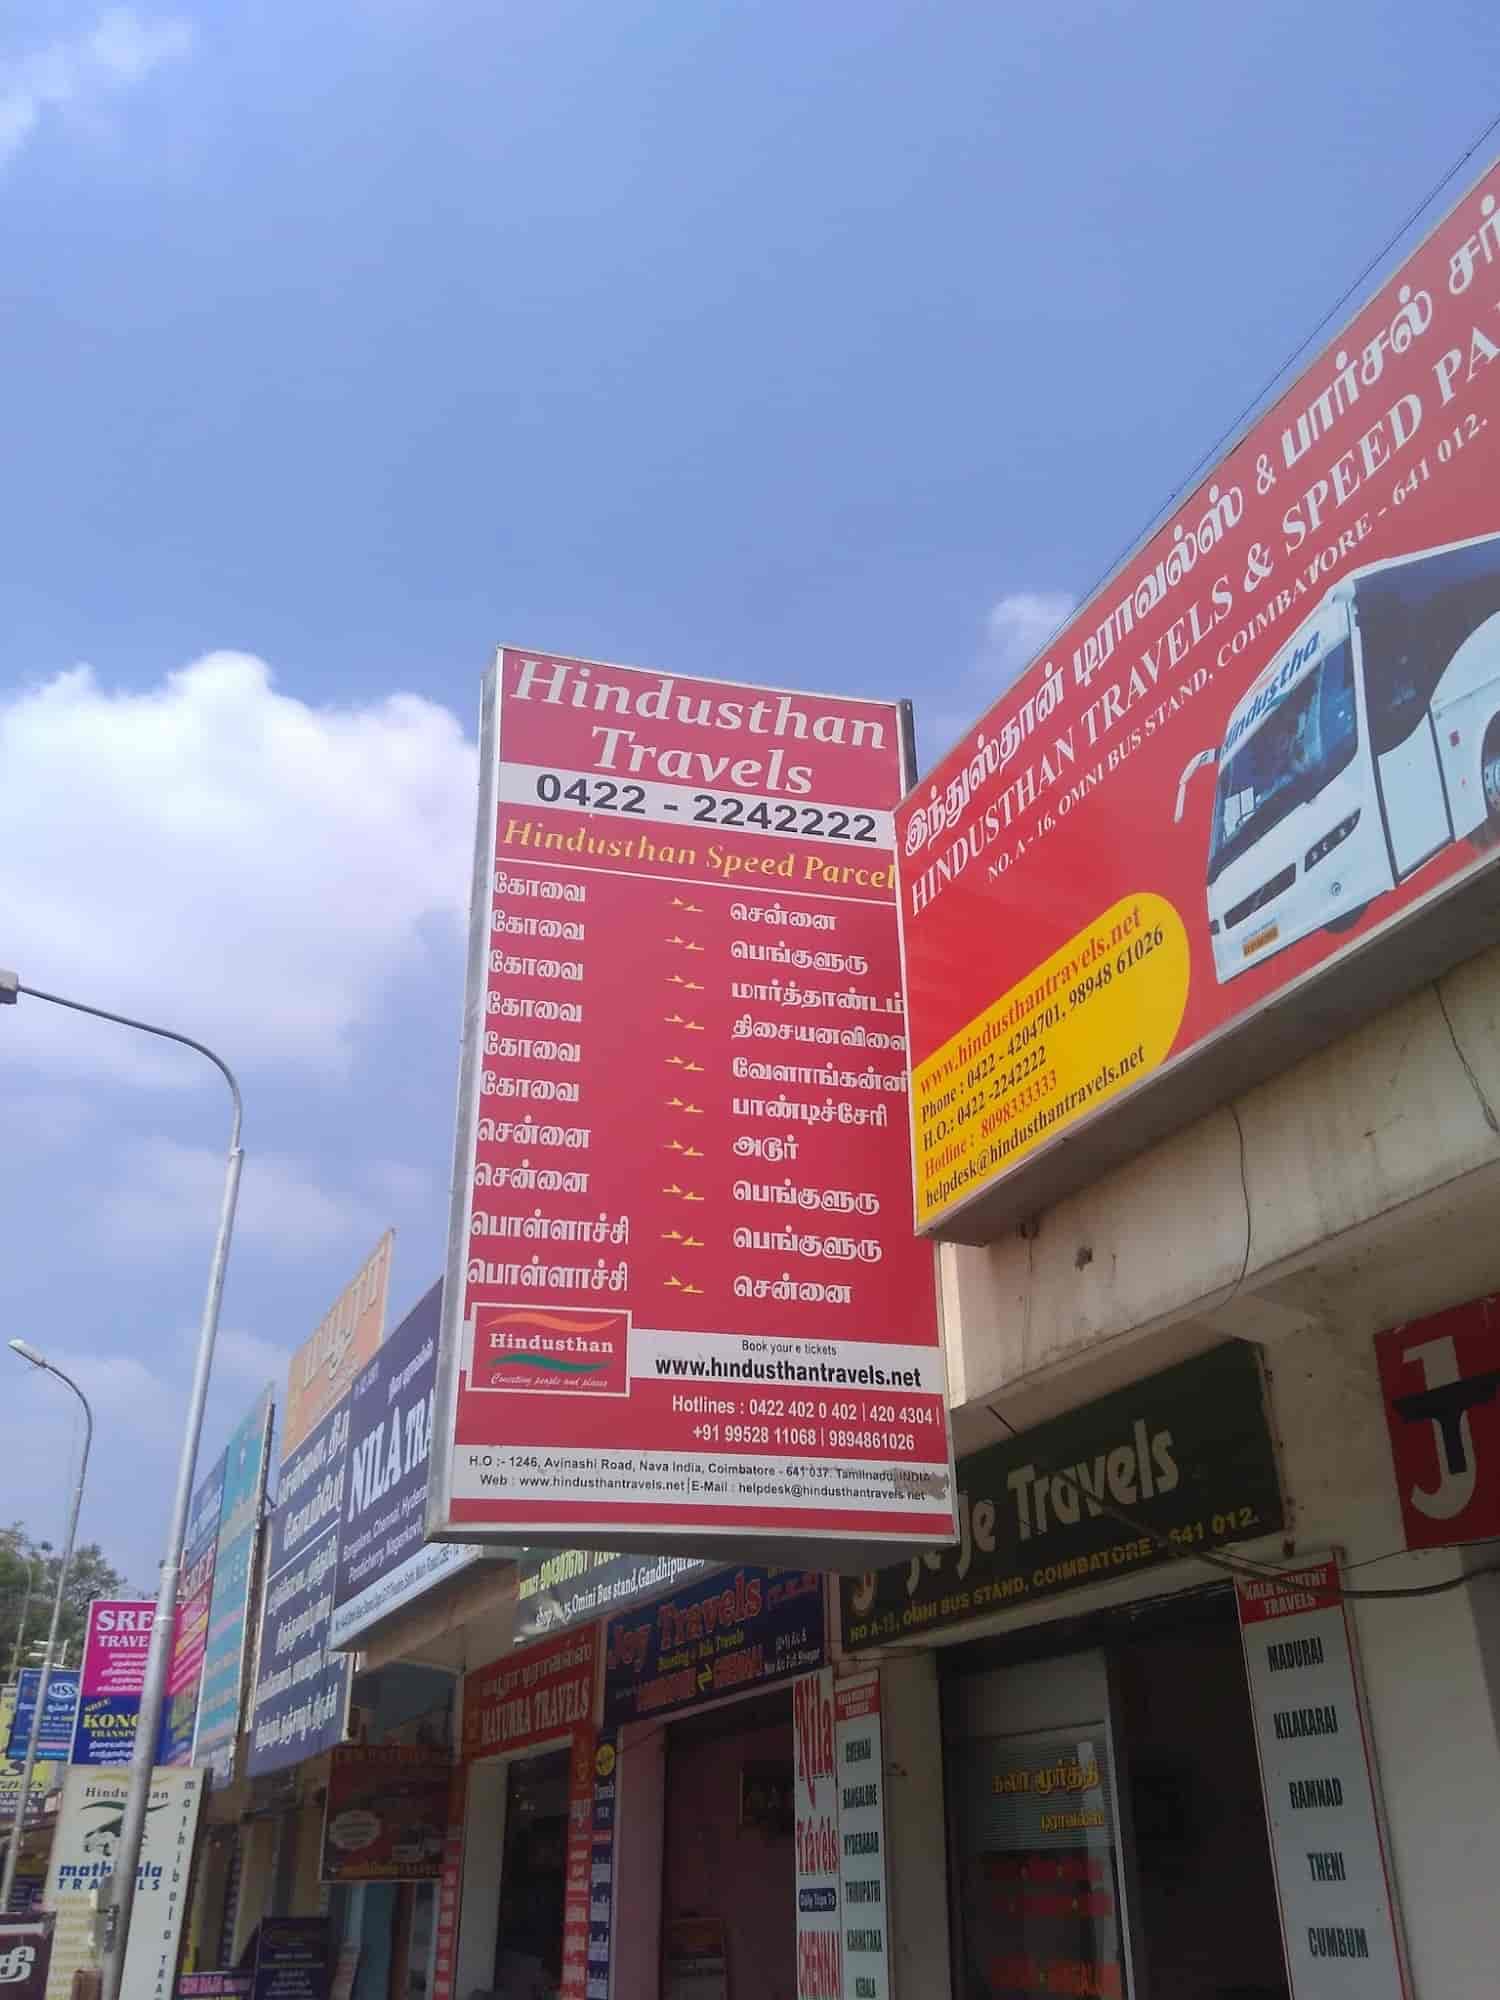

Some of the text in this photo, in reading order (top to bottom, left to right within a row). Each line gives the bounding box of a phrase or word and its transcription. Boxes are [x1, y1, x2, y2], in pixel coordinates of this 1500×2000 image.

[1281, 285, 1432, 469] பார்சல்
[911, 327, 1500, 916] HINDUSTHAN TRAVELS & SPEED PA
[1058, 764, 1104, 816] OMNI
[1108, 728, 1142, 771] BUS
[1217, 512, 1373, 667] COIMBATORE
[1392, 457, 1430, 505] 641
[510, 657, 887, 750] Hindusthan
[592, 726, 813, 795] Travels
[536, 773, 646, 814] 0422
[693, 794, 877, 842] 2242222
[503, 819, 896, 889] Hindusthan Speed Parcel
[494, 871, 838, 931] கோவை சென்னை
[491, 909, 585, 942] கோவை
[489, 949, 584, 982] கோவை
[486, 989, 583, 1023] கோவை
[920, 904, 1143, 1094] www.hindusthantravels.net
[921, 1086, 957, 1124] Phone
[967, 1053, 996, 1089] 0422
[1069, 966, 1113, 1008] 98948
[1117, 925, 1164, 975] 61026
[484, 1030, 581, 1063] கோவை
[481, 1070, 580, 1103] கோவை
[477, 1115, 591, 1149] சென்னை
[474, 1159, 590, 1194] சென்னை
[925, 1140, 967, 1181] Hotline
[471, 1208, 630, 1246] பொள்ளாச்சி
[467, 1255, 853, 1304] பொள்ளாச்சி சென்னை
[490, 1333, 613, 1353] Hindusthan
[742, 1340, 768, 1352] Book
[770, 1342, 793, 1355] your
[655, 1357, 922, 1388] www.hindusthantravels.net
[672, 1395, 736, 1415] Hotlines
[750, 1400, 785, 1417] 0422
[788, 1401, 814, 1418] 402
[832, 1403, 857, 1421] 402
[870, 1404, 896, 1422] 420
[899, 1405, 933, 1425] 4304
[693, 1423, 915, 1450] +91 99528 11068 9894861026
[348, 1405, 402, 1522] NILA
[544, 1456, 597, 1470] Avinashi
[601, 1458, 636, 1473] Road,
[639, 1460, 669, 1473] Nava
[708, 1462, 776, 1477] Coimbatore
[1008, 1418, 1180, 1542] Travels
[480, 1473, 507, 1487] Web
[519, 1475, 685, 1492] www.hindusthantravels.net
[1032, 1535, 1154, 1586] COIMBATORE
[96, 1609, 154, 1632] SRE
[98, 1635, 148, 1649] TRAVE
[1266, 1636, 1324, 1673] MADURAI
[535, 1677, 592, 1732] TRAVELS
[1273, 1704, 1338, 1741] KILAKARAI
[85, 1786, 169, 1799] Hinduan
[1288, 1775, 1344, 1809] RAMNAD
[1307, 1850, 1347, 1884] THENI
[58, 1878, 161, 1892] TRALS
[1307, 1926, 1369, 1959] CUMBUM
